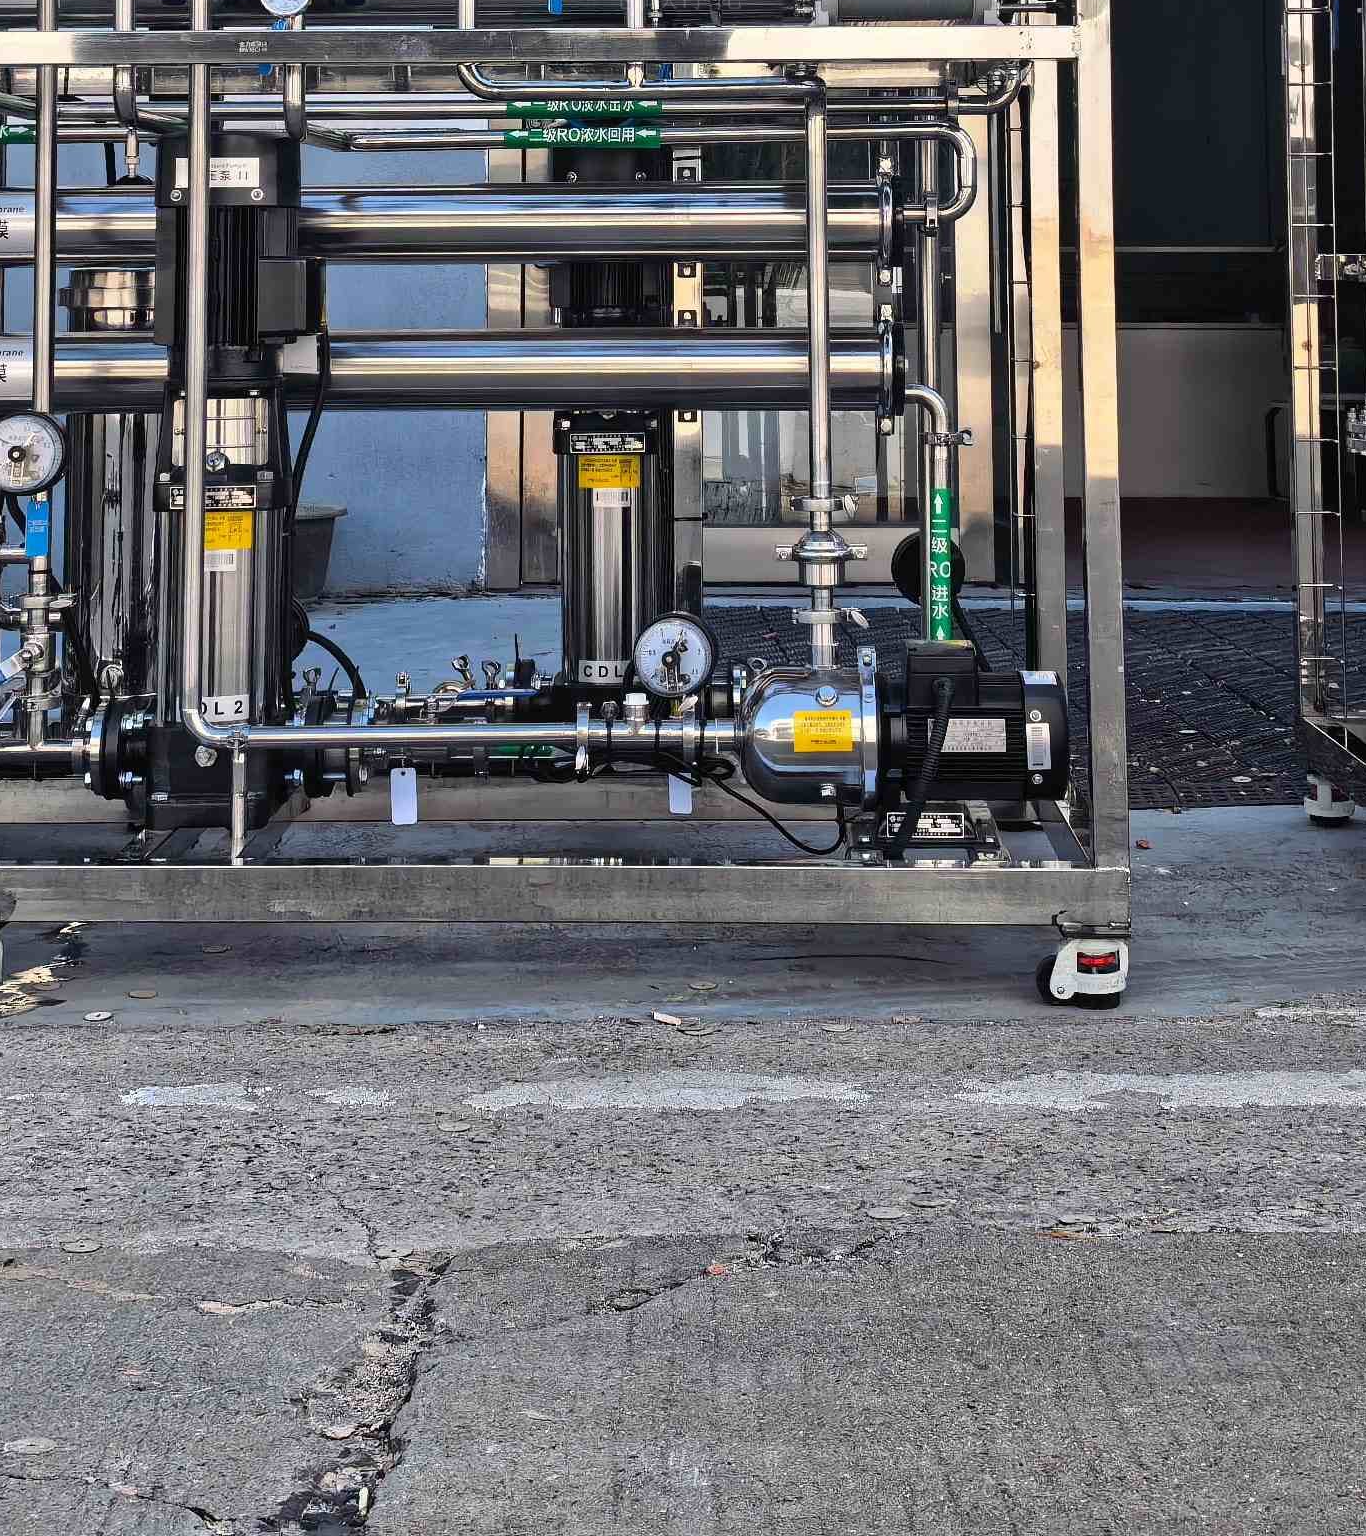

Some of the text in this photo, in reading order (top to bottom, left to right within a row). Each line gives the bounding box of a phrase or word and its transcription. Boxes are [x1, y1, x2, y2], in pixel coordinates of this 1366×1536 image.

[528, 127, 635, 143] 二级RO浓水回用
[929, 519, 951, 620] 二级RO进水
